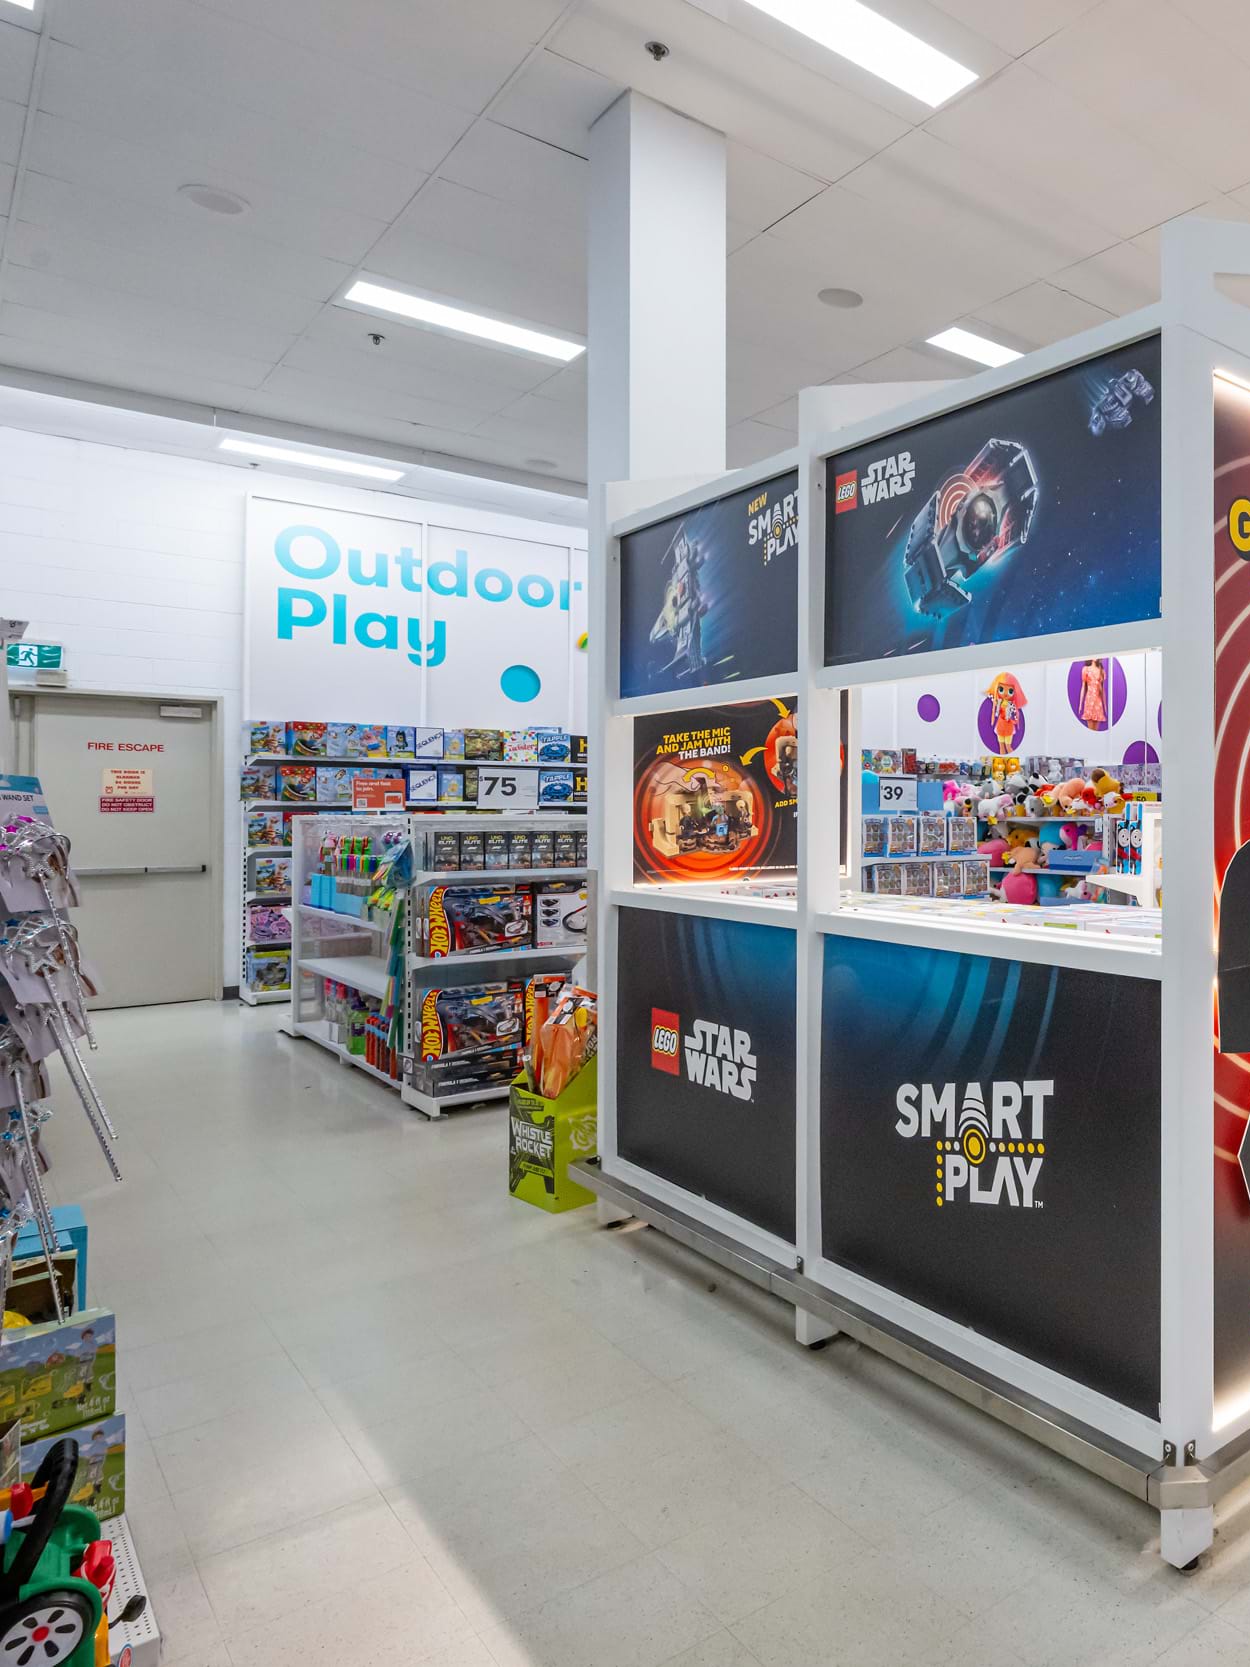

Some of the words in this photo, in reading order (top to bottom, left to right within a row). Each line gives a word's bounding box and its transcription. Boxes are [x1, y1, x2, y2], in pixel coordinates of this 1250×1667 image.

[861, 451, 916, 486] STAR
[837, 481, 857, 502] LEGO
[861, 470, 916, 506] WARS
[748, 491, 768, 517] NEW
[274, 524, 582, 610] Outdoor
[276, 587, 447, 668] Play
[87, 742, 114, 751] FIRE
[118, 743, 165, 752] ESCAPE
[416, 731, 443, 750] SEQUENCE
[656, 742, 679, 754] AND
[680, 739, 702, 752] JAM
[703, 735, 731, 748] WITH
[663, 732, 690, 744] TAKE
[691, 729, 711, 740] THE
[712, 726, 731, 737] MIC
[678, 750, 698, 761] THE
[699, 744, 731, 757] BAND!
[410, 773, 437, 793] SEQUENCE
[479, 775, 517, 796] $75
[2, 794, 22, 802] WAND
[23, 794, 34, 802] SET
[774, 799, 789, 809] ADD
[430, 926, 449, 954] HOT
[422, 1030, 442, 1057] HOT
[653, 1026, 679, 1055] LEGO
[684, 1018, 757, 1069] STAR
[684, 1048, 757, 1101] WARS
[895, 1079, 1055, 1138] SMART
[511, 1116, 553, 1146] WHISTLE
[515, 1135, 553, 1161] ROCKET
[945, 1154, 1044, 1208] PLAY
